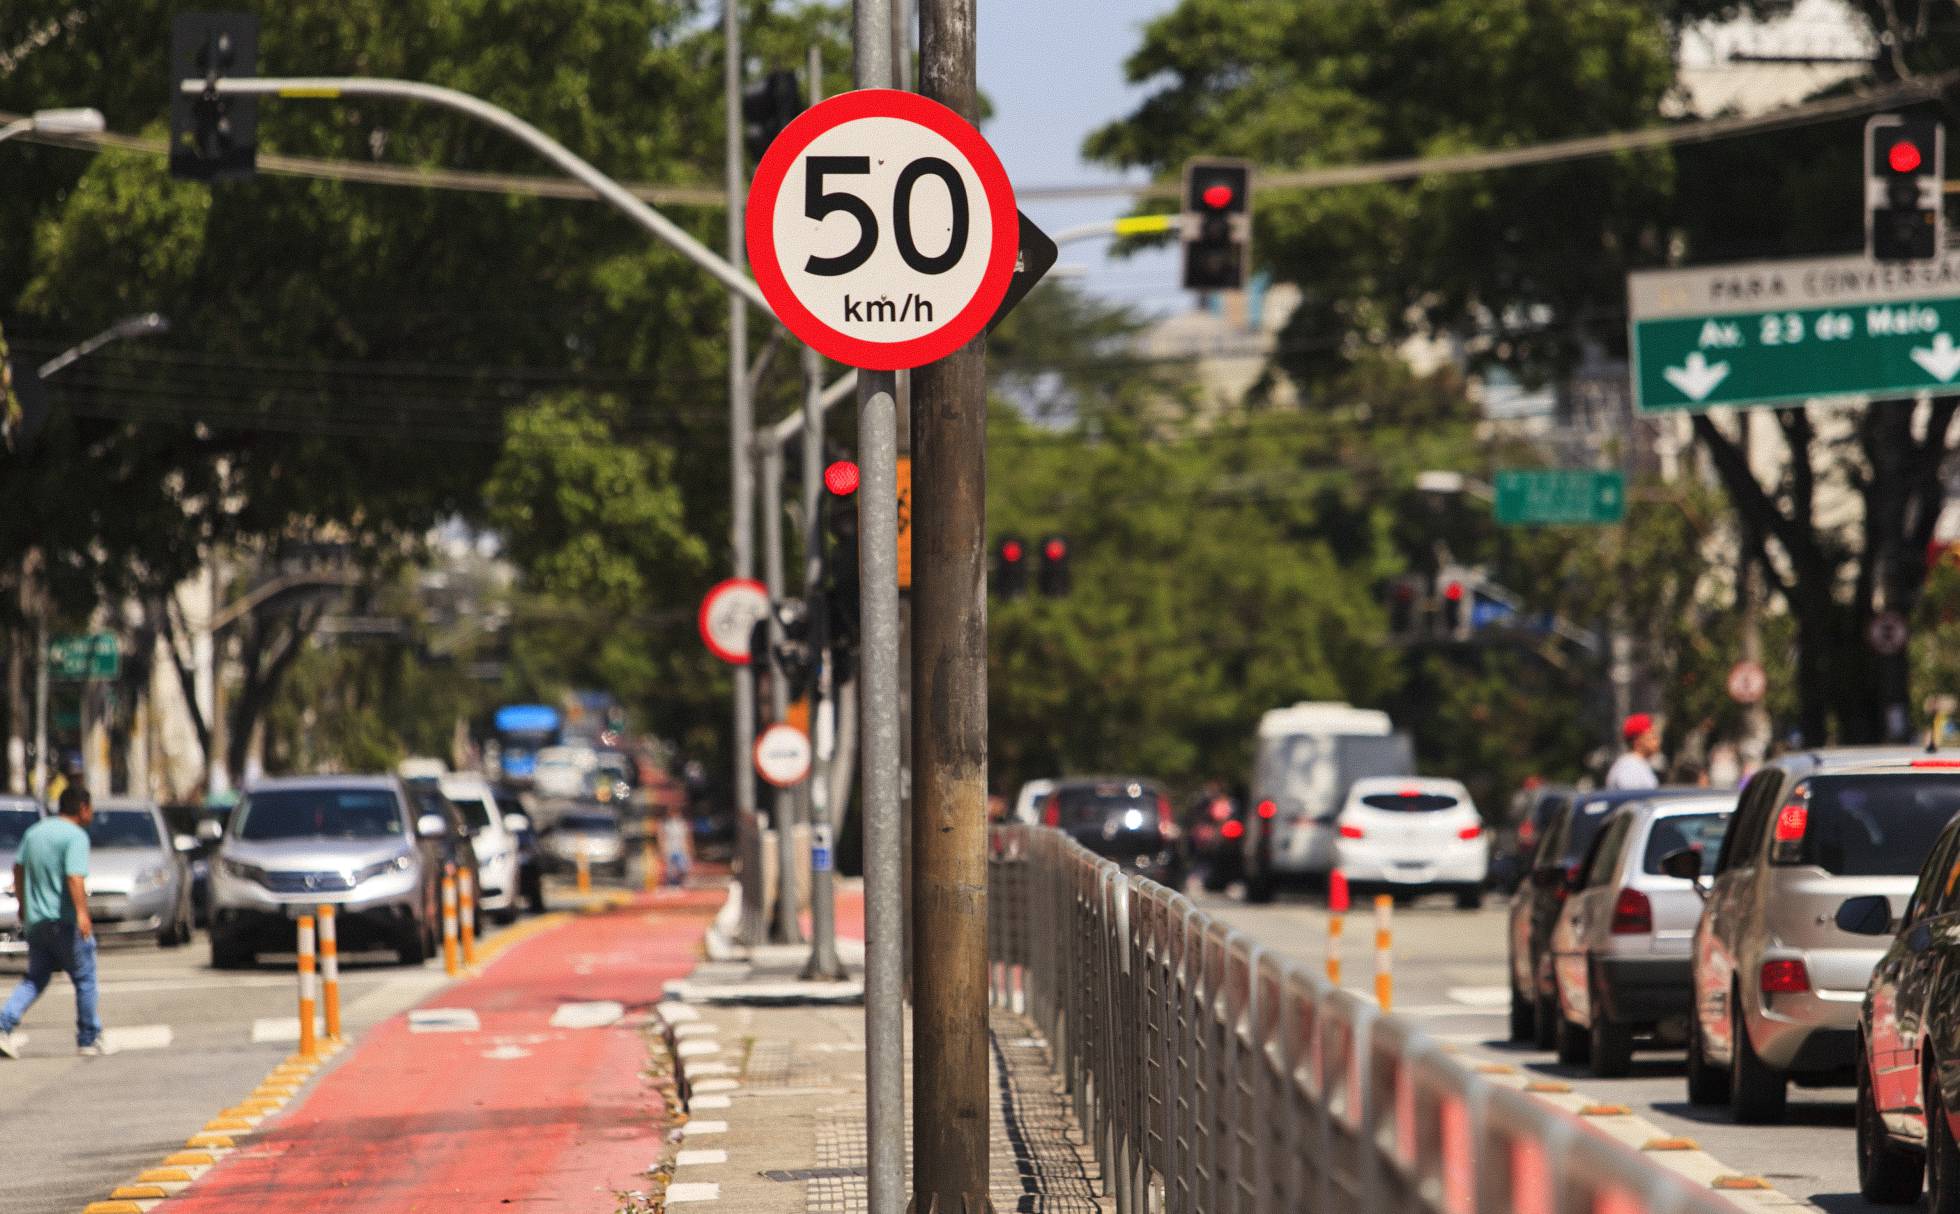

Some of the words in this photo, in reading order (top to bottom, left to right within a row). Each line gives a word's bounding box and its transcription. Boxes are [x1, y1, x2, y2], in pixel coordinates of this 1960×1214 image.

[804, 156, 969, 276] 50
[844, 293, 933, 322] km/h
[1760, 313, 1804, 345] 23
[1815, 311, 1854, 341] de
[1866, 303, 1940, 337] Maio
